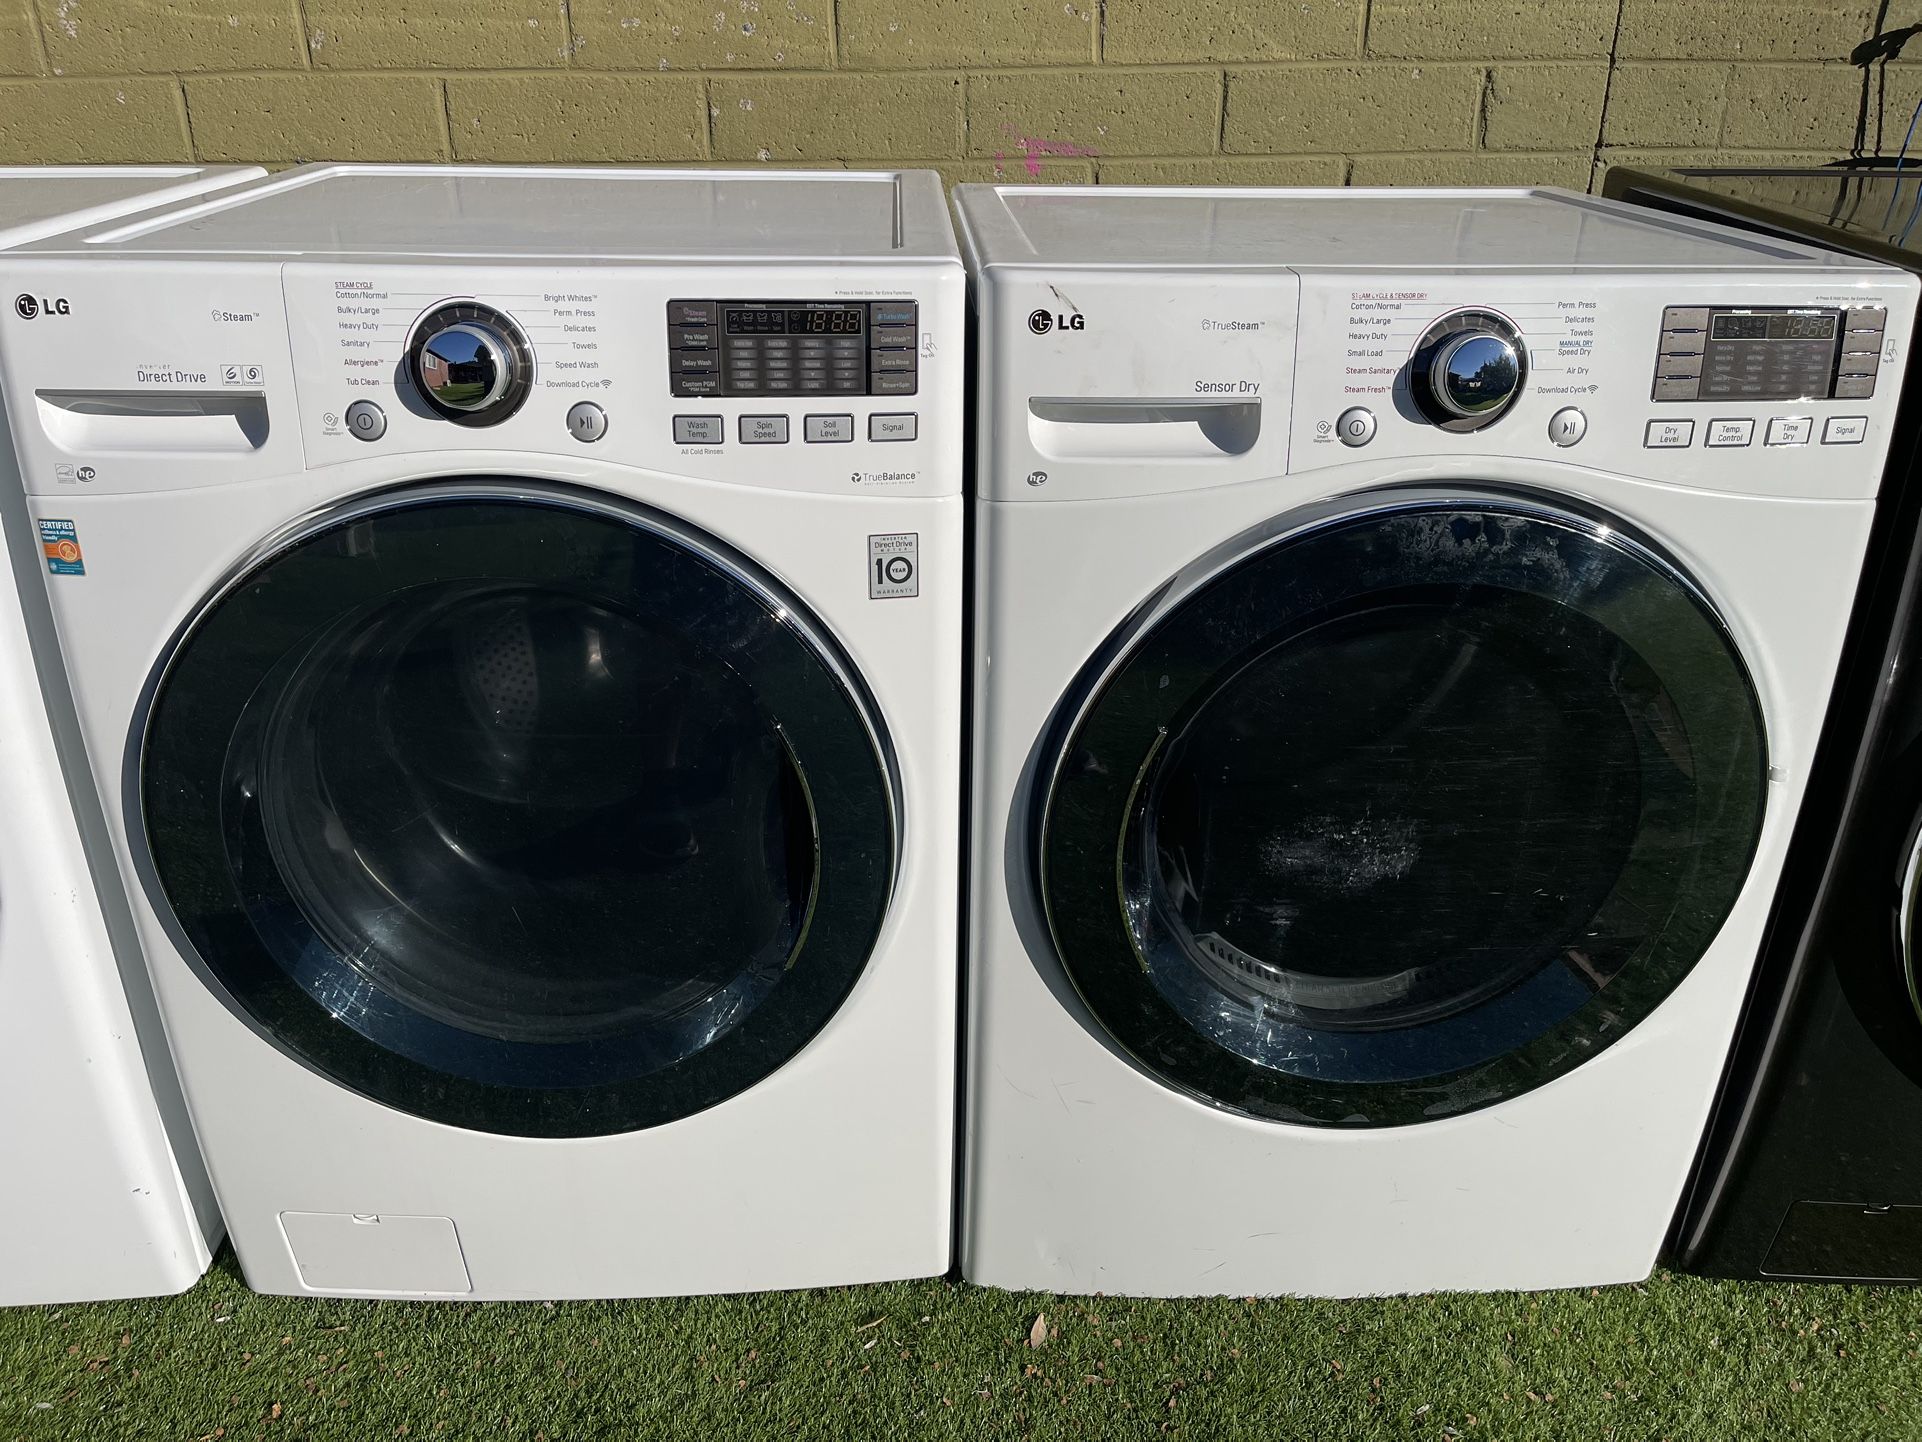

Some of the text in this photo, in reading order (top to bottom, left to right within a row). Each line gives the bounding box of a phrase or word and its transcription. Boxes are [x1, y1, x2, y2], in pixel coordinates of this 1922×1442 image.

[544, 294, 566, 303] Bright
[43, 298, 70, 314] LG
[337, 306, 380, 315] Bulky/Large
[339, 322, 378, 330] Heavy Duty
[1058, 314, 1084, 330] LG
[1350, 317, 1391, 326] Bulky/Large
[341, 340, 370, 348] Sanitary
[1558, 348, 1591, 356] Speed Dry
[556, 361, 577, 369] Speed
[1578, 367, 1590, 375] Dry
[138, 371, 206, 382] Direct Drive
[1195, 380, 1260, 395] Sensor Dry
[1570, 386, 1586, 394] Cycle
[687, 421, 708, 430] Wash
[756, 421, 772, 430] Spin
[882, 423, 904, 432] Signal
[1664, 426, 1678, 434] Dry
[1722, 426, 1742, 434] Temp.
[1836, 426, 1855, 434] Signal
[754, 430, 776, 439] Speed
[820, 429, 840, 438] Level
[1783, 433, 1796, 441] Dry
[39, 521, 74, 530] CERTIFIED
[876, 556, 912, 584] 10
